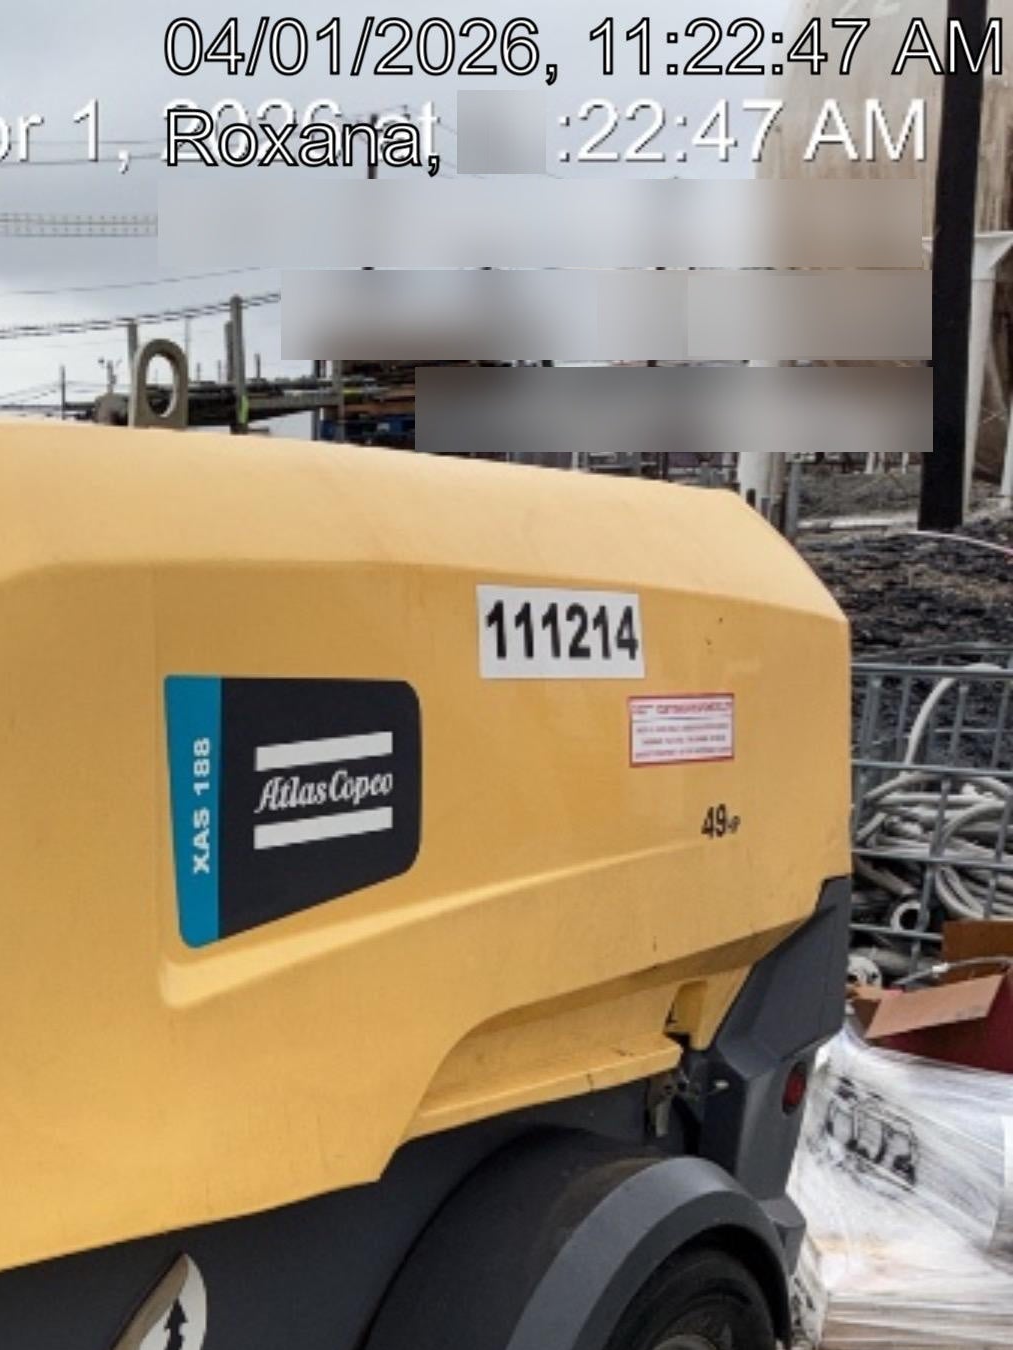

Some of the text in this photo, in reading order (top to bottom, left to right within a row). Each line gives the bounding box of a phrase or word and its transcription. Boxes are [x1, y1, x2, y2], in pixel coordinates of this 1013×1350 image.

[486, 600, 639, 660] 111214
[193, 737, 210, 874] XAS 188
